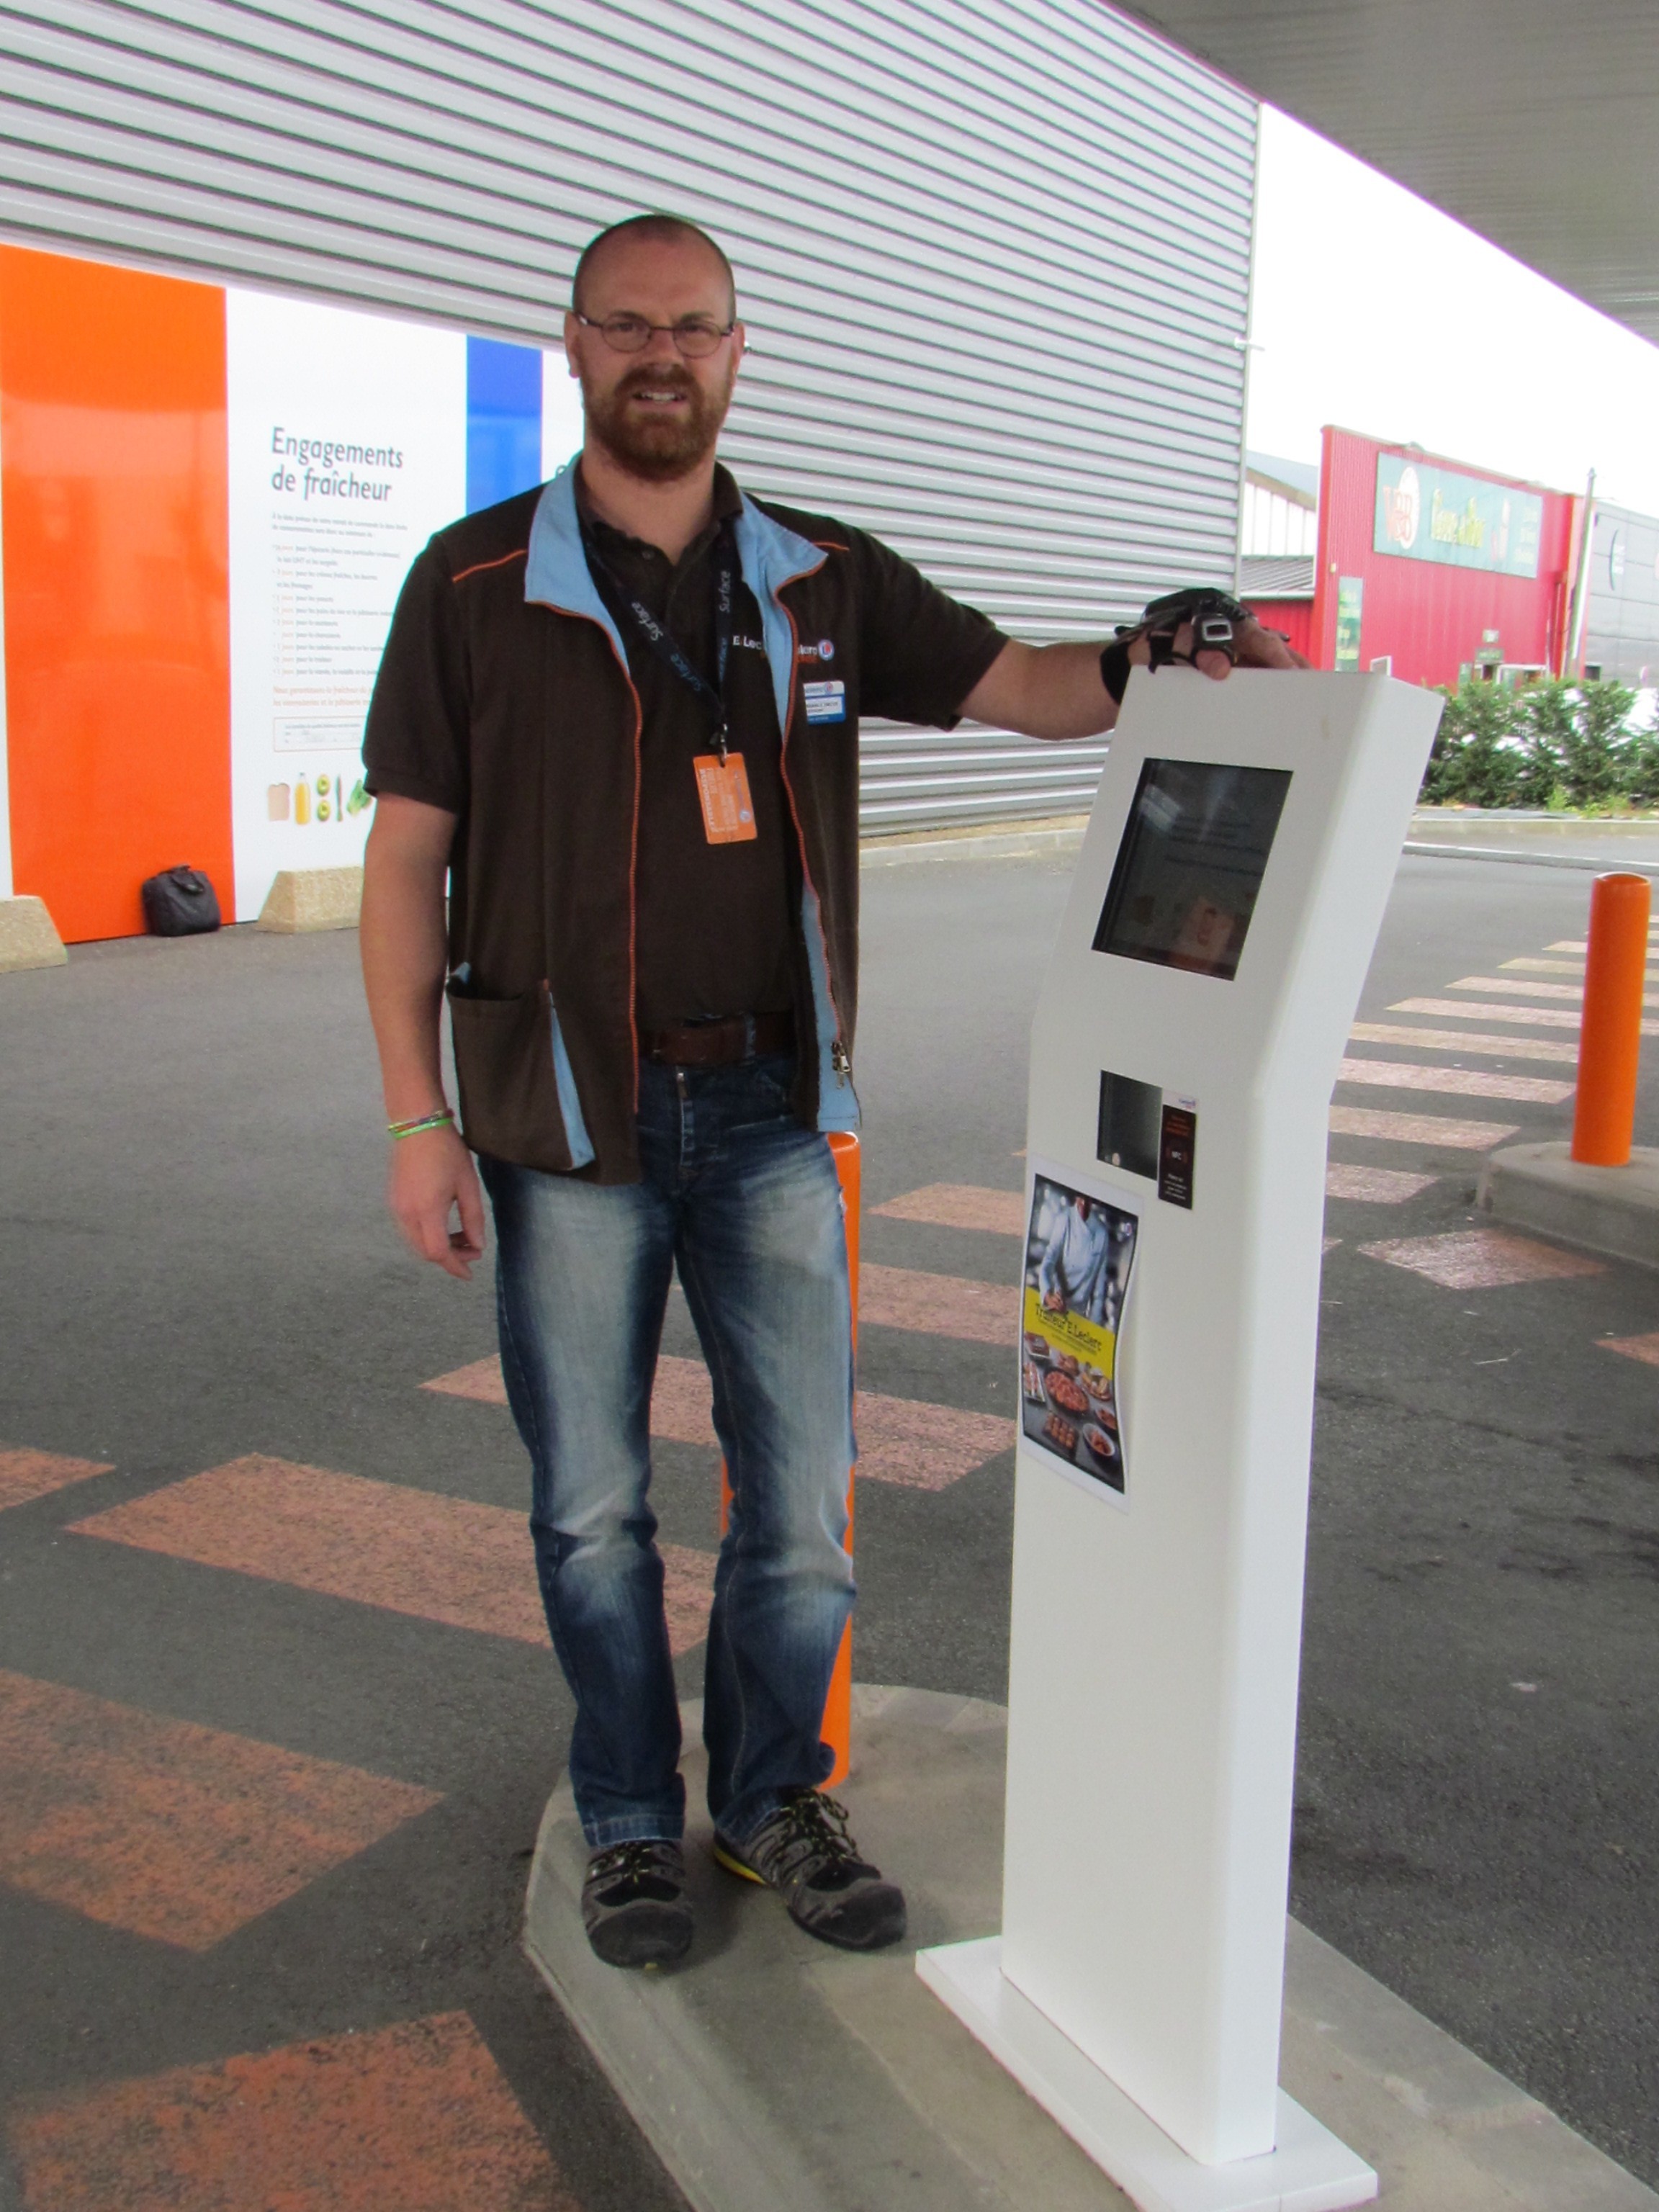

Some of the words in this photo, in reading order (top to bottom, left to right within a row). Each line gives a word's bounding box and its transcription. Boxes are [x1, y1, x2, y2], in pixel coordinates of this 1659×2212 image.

[271, 426, 403, 469] Engagements
[271, 464, 296, 492] de
[303, 467, 392, 501] fraîcheur
[719, 570, 732, 613] Surface
[631, 601, 664, 642] Surface
